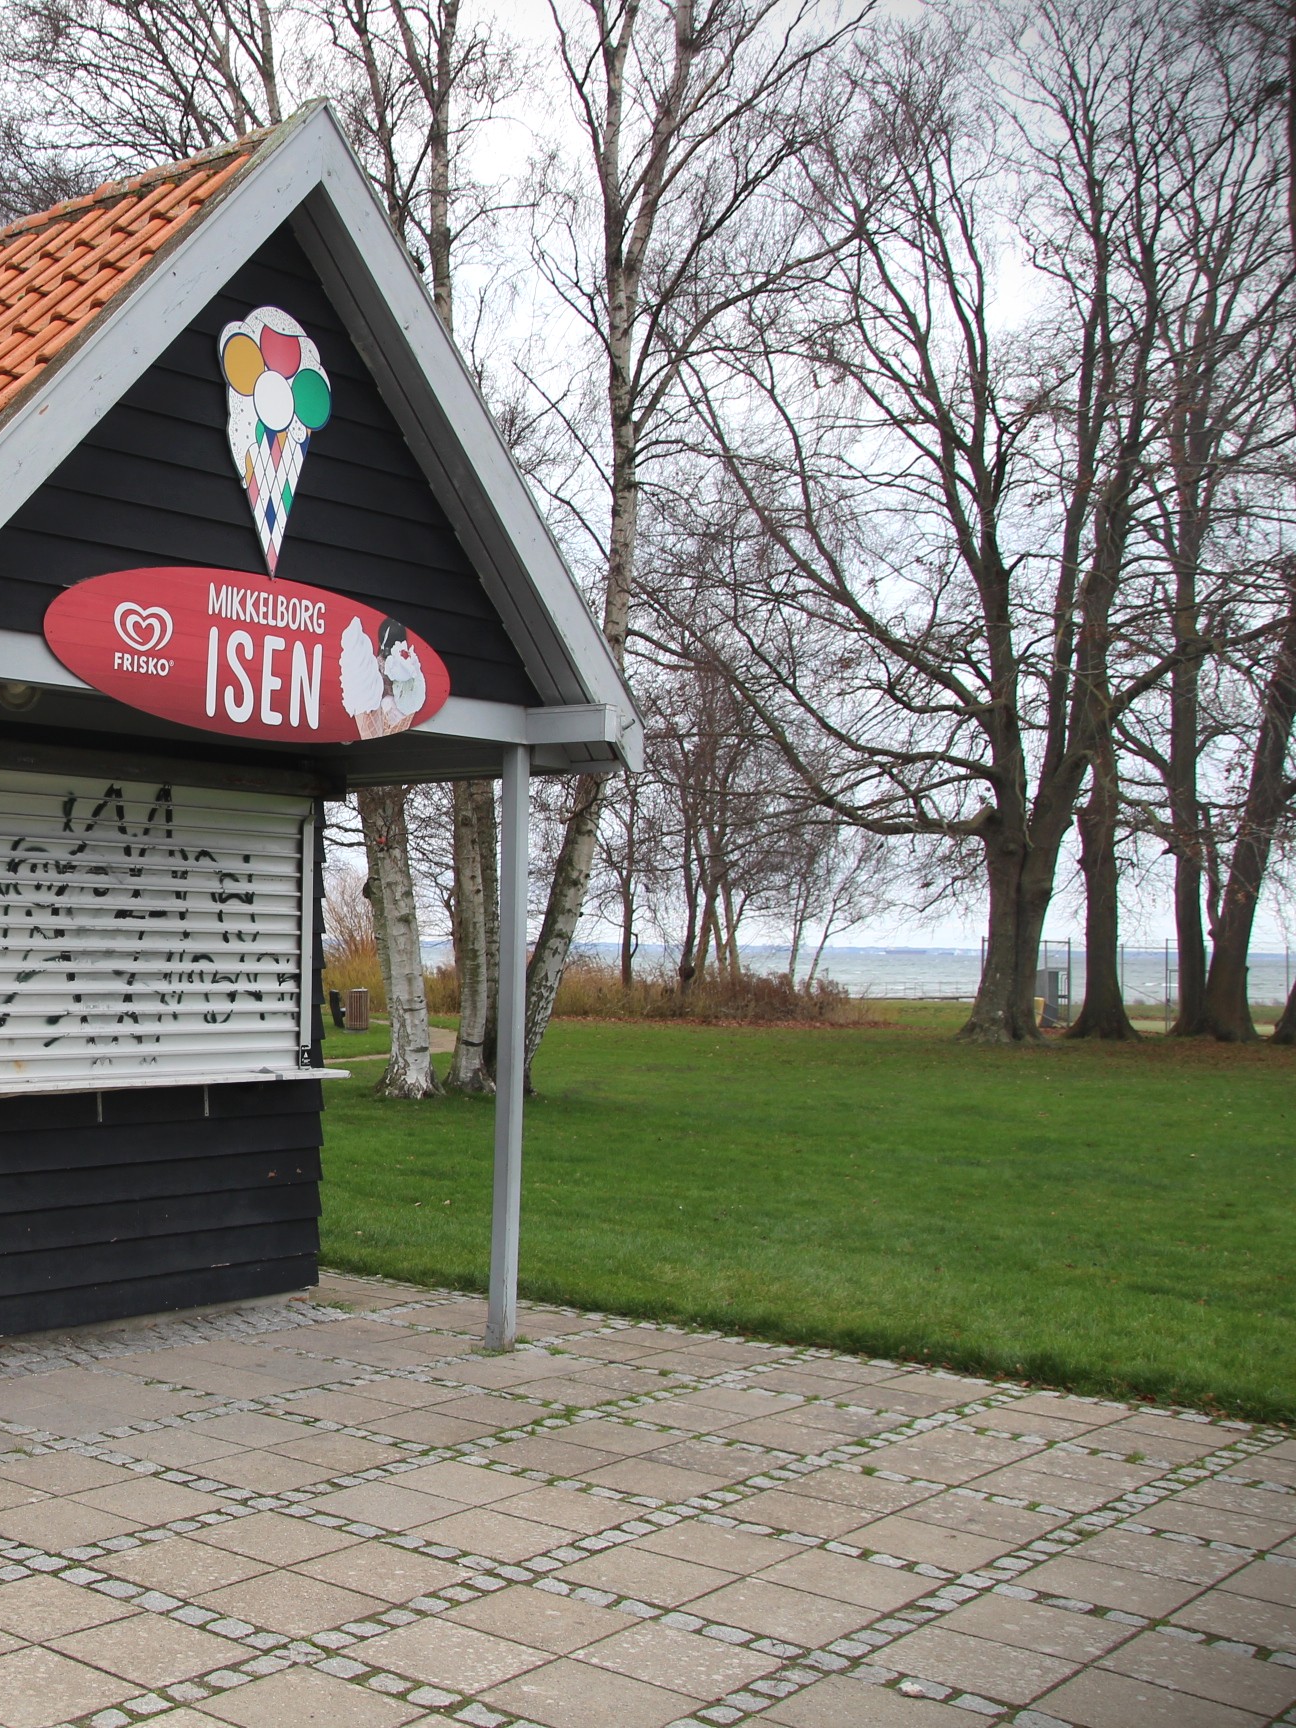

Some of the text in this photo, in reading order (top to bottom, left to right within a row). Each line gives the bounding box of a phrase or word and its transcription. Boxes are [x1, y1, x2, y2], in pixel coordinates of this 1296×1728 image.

[208, 582, 325, 634] MIKKELBORG
[114, 651, 170, 676] FRISKO
[205, 626, 323, 730] ISEN
